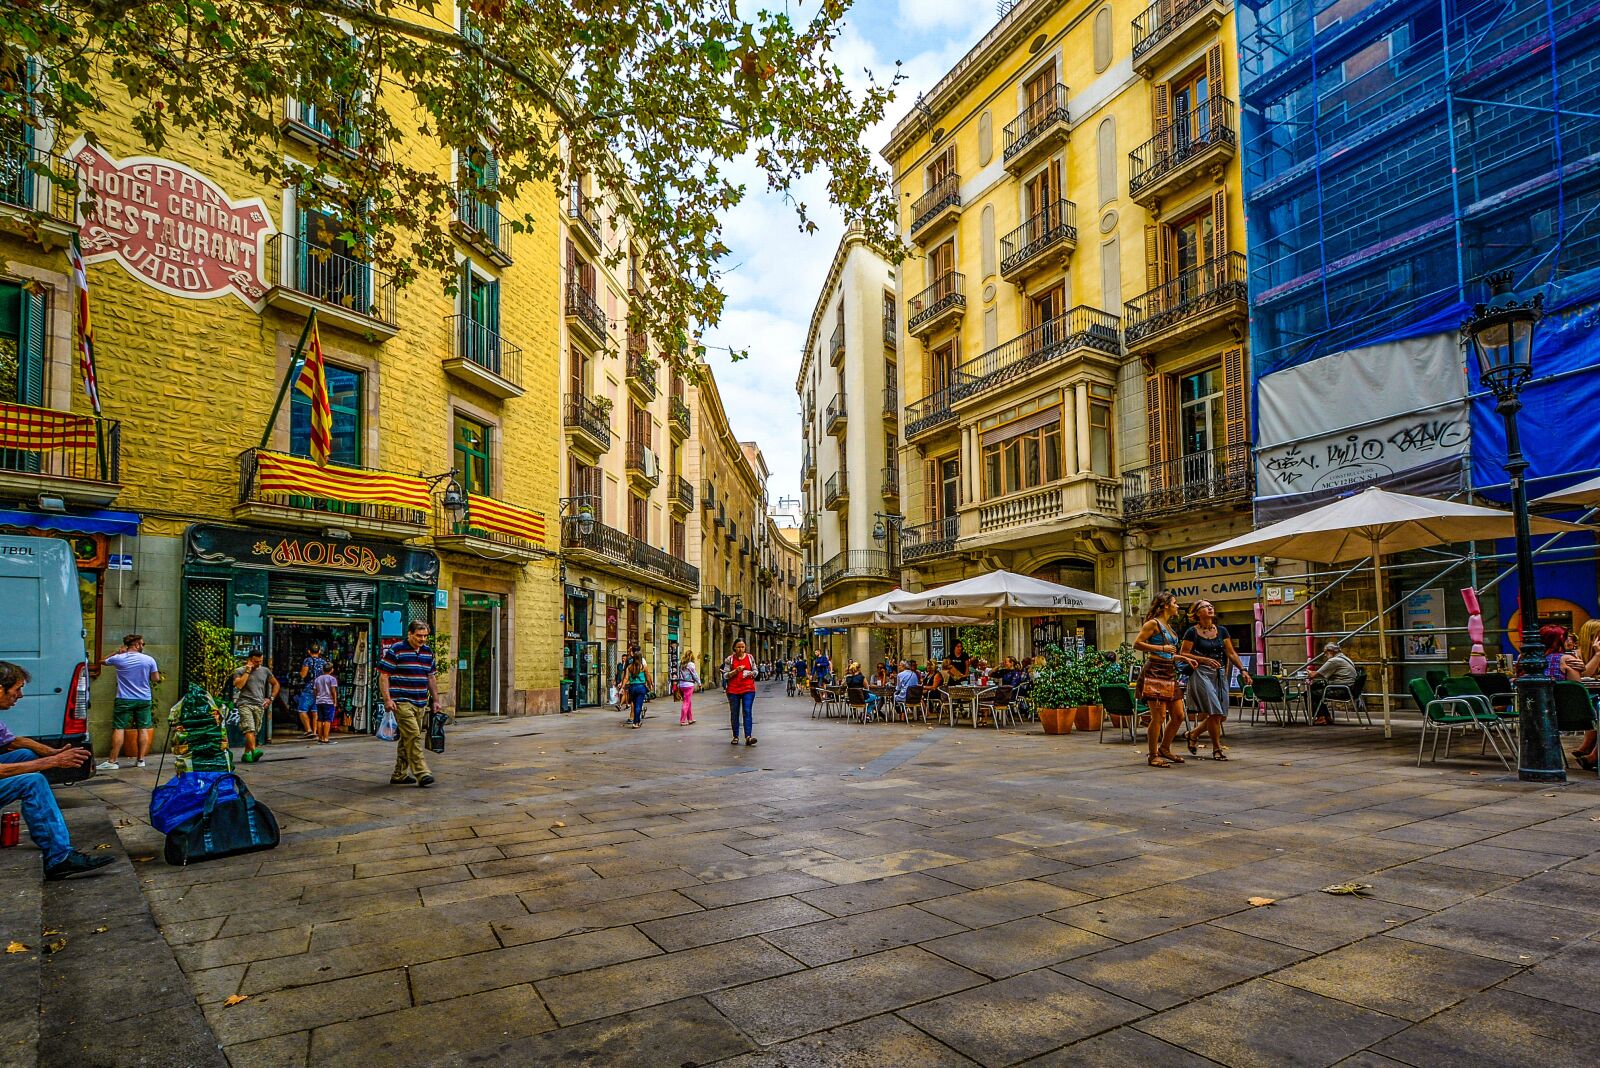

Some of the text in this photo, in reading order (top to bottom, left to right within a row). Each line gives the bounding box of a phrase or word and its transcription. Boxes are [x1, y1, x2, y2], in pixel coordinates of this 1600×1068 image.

[132, 166, 221, 206] GRAN
[87, 166, 255, 240] HOTEL CENTRAL
[154, 243, 195, 265] DEL
[271, 538, 381, 575] MOLSA
[926, 597, 958, 608] Pa Tapas
[1052, 595, 1084, 607] Pa Tapas
